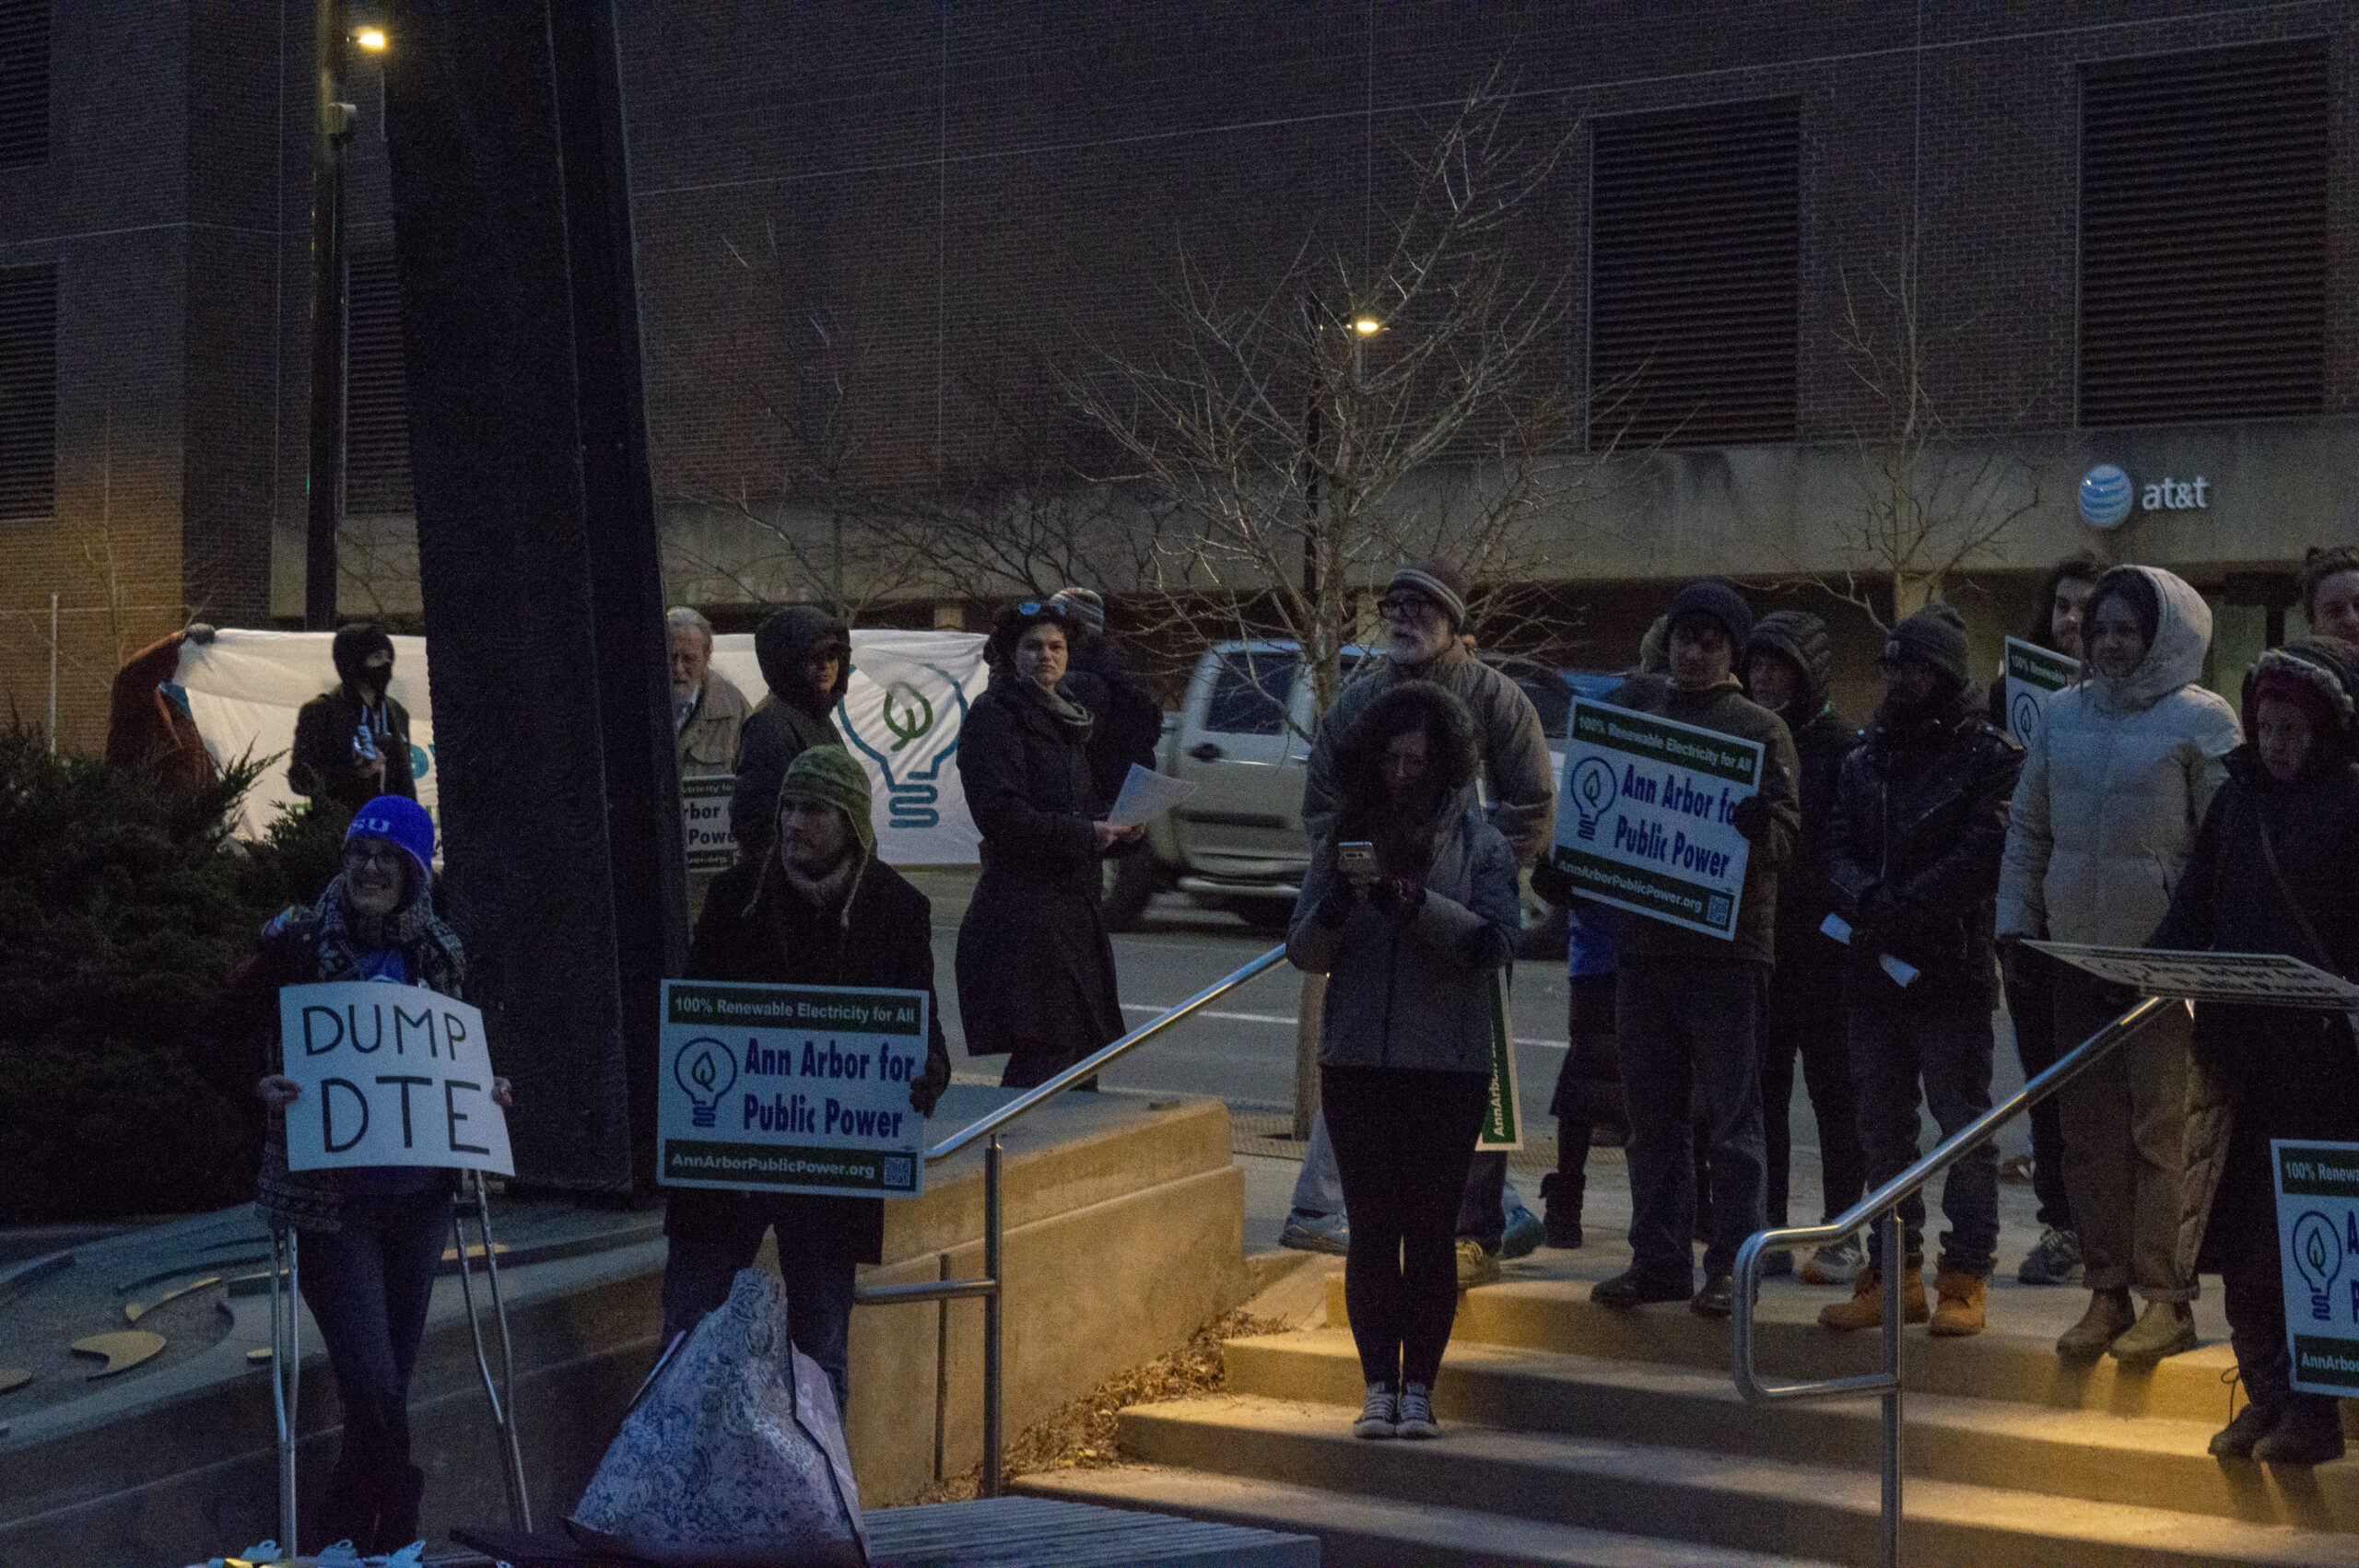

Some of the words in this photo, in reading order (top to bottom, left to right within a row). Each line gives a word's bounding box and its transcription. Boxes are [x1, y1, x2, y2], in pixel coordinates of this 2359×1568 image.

[2142, 476, 2211, 510] at&t
[1666, 737, 1719, 766] Electricity
[1720, 752, 1736, 768] for
[1622, 764, 1657, 804] Ann
[1661, 775, 1714, 819] Arbor
[1614, 815, 1668, 862] Public
[1672, 831, 1731, 879] Power
[1558, 860, 1703, 914] AnnArborPublicPower.org
[302, 1004, 466, 1060] DUMP
[675, 995, 713, 1014] 100%
[717, 999, 793, 1017] Renewable
[797, 1002, 869, 1024] Electricity
[873, 1006, 893, 1022] for
[896, 1007, 915, 1023] All
[744, 1037, 791, 1077] Ann
[799, 1040, 870, 1080] Arbor
[879, 1042, 915, 1082] for
[321, 1075, 490, 1155] DTE
[744, 1094, 816, 1133] Public
[825, 1097, 903, 1139] Power
[671, 1153, 875, 1179] AnnArborPublicPower.org
[2285, 1161, 2317, 1180] 100%
[2318, 1163, 2359, 1183] Renew
